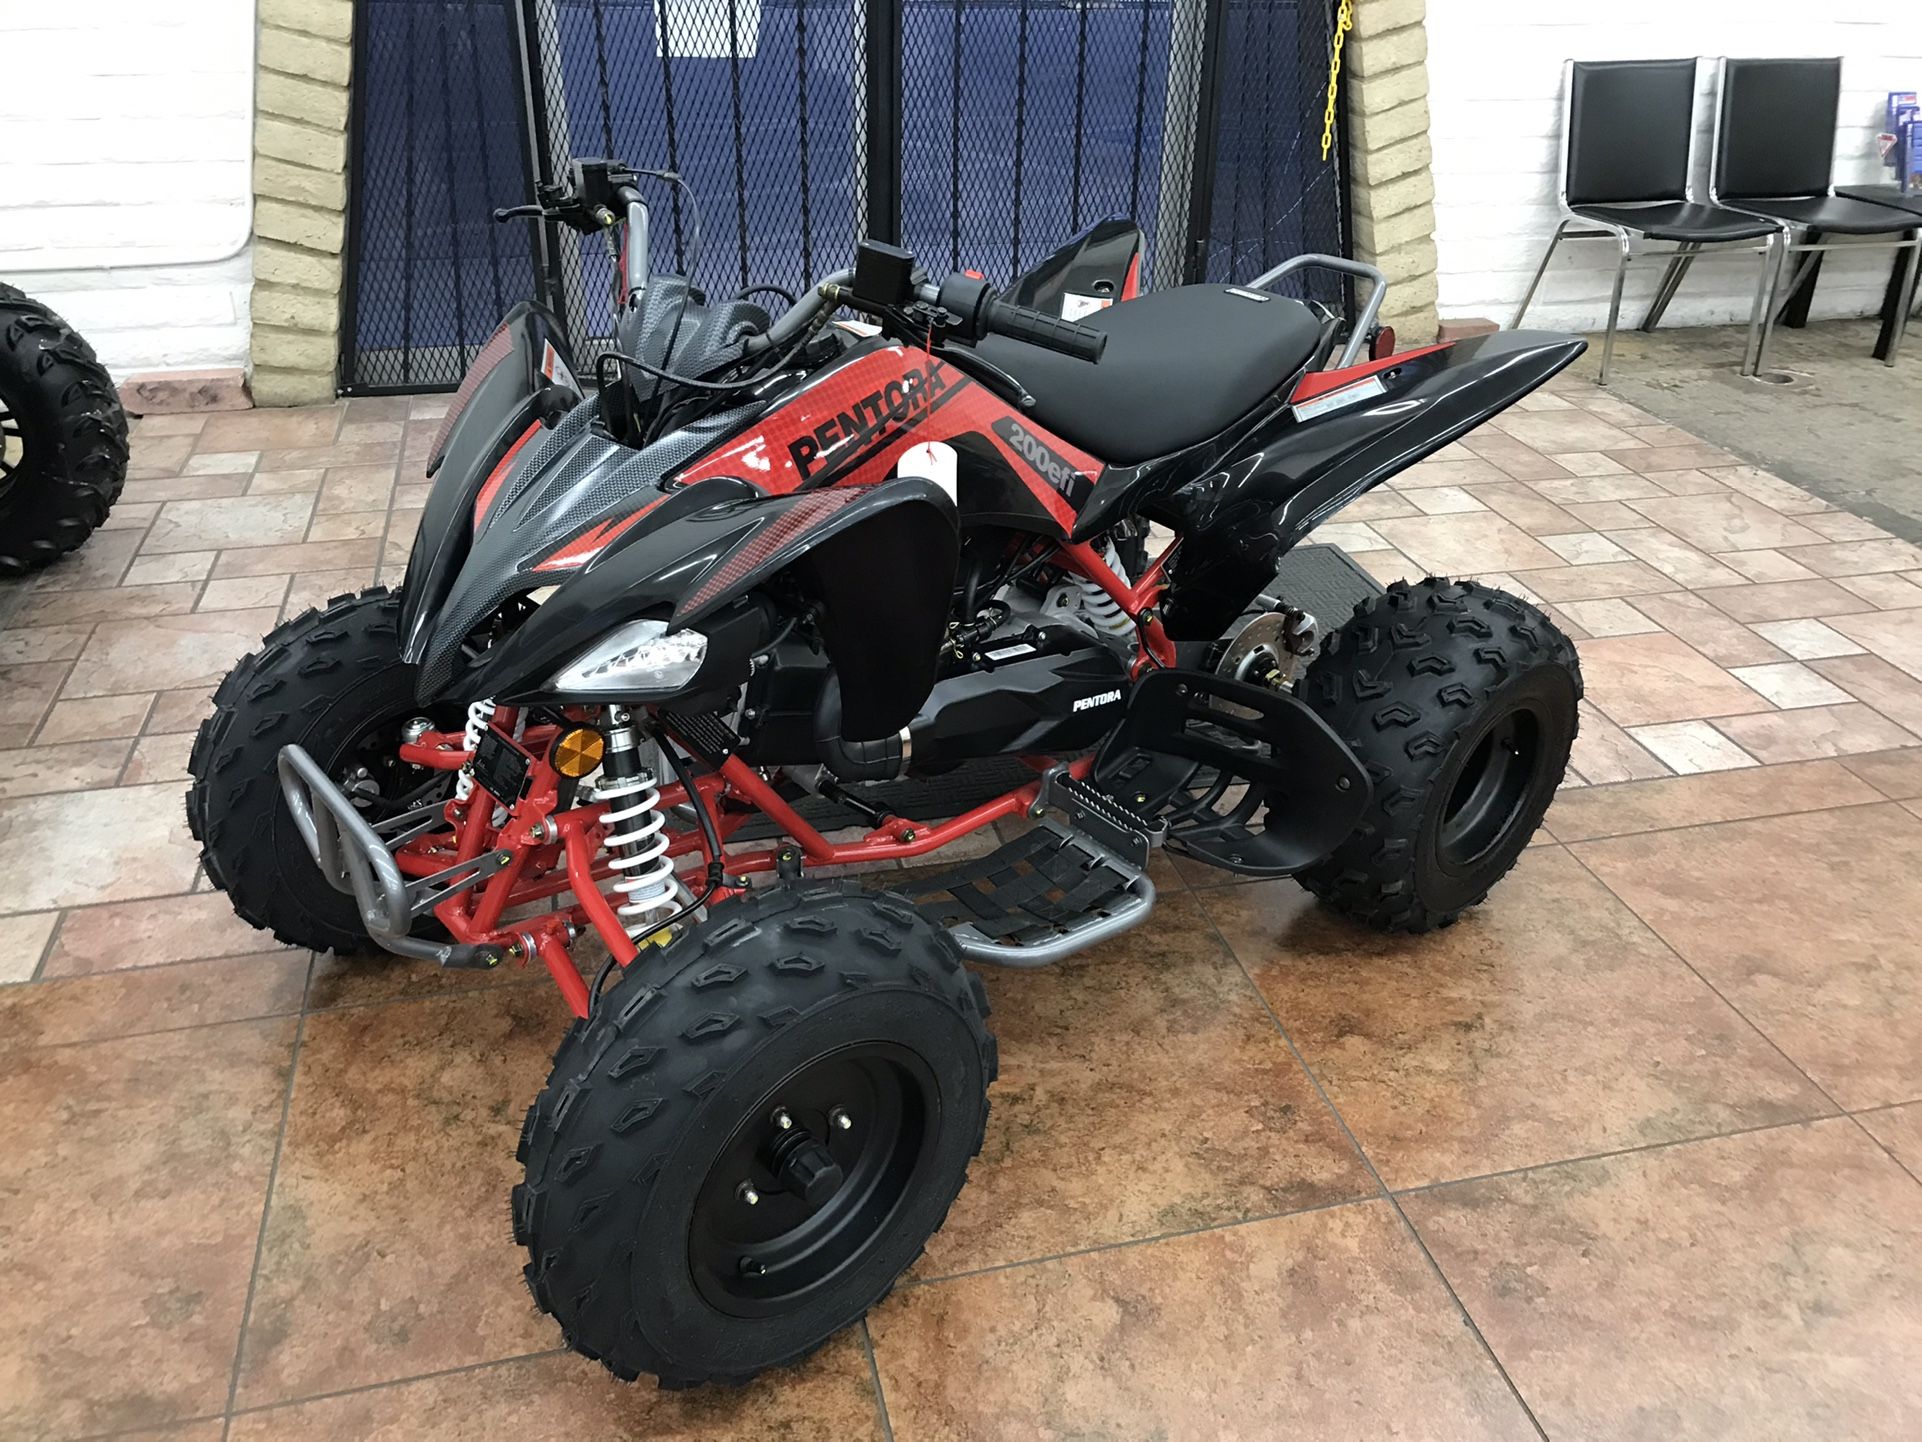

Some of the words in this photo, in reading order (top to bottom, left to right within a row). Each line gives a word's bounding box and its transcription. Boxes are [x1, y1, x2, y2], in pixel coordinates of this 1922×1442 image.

[788, 360, 945, 482] PENTORA
[1009, 423, 1076, 497] 200efi
[1073, 689, 1121, 712] PENTORA
